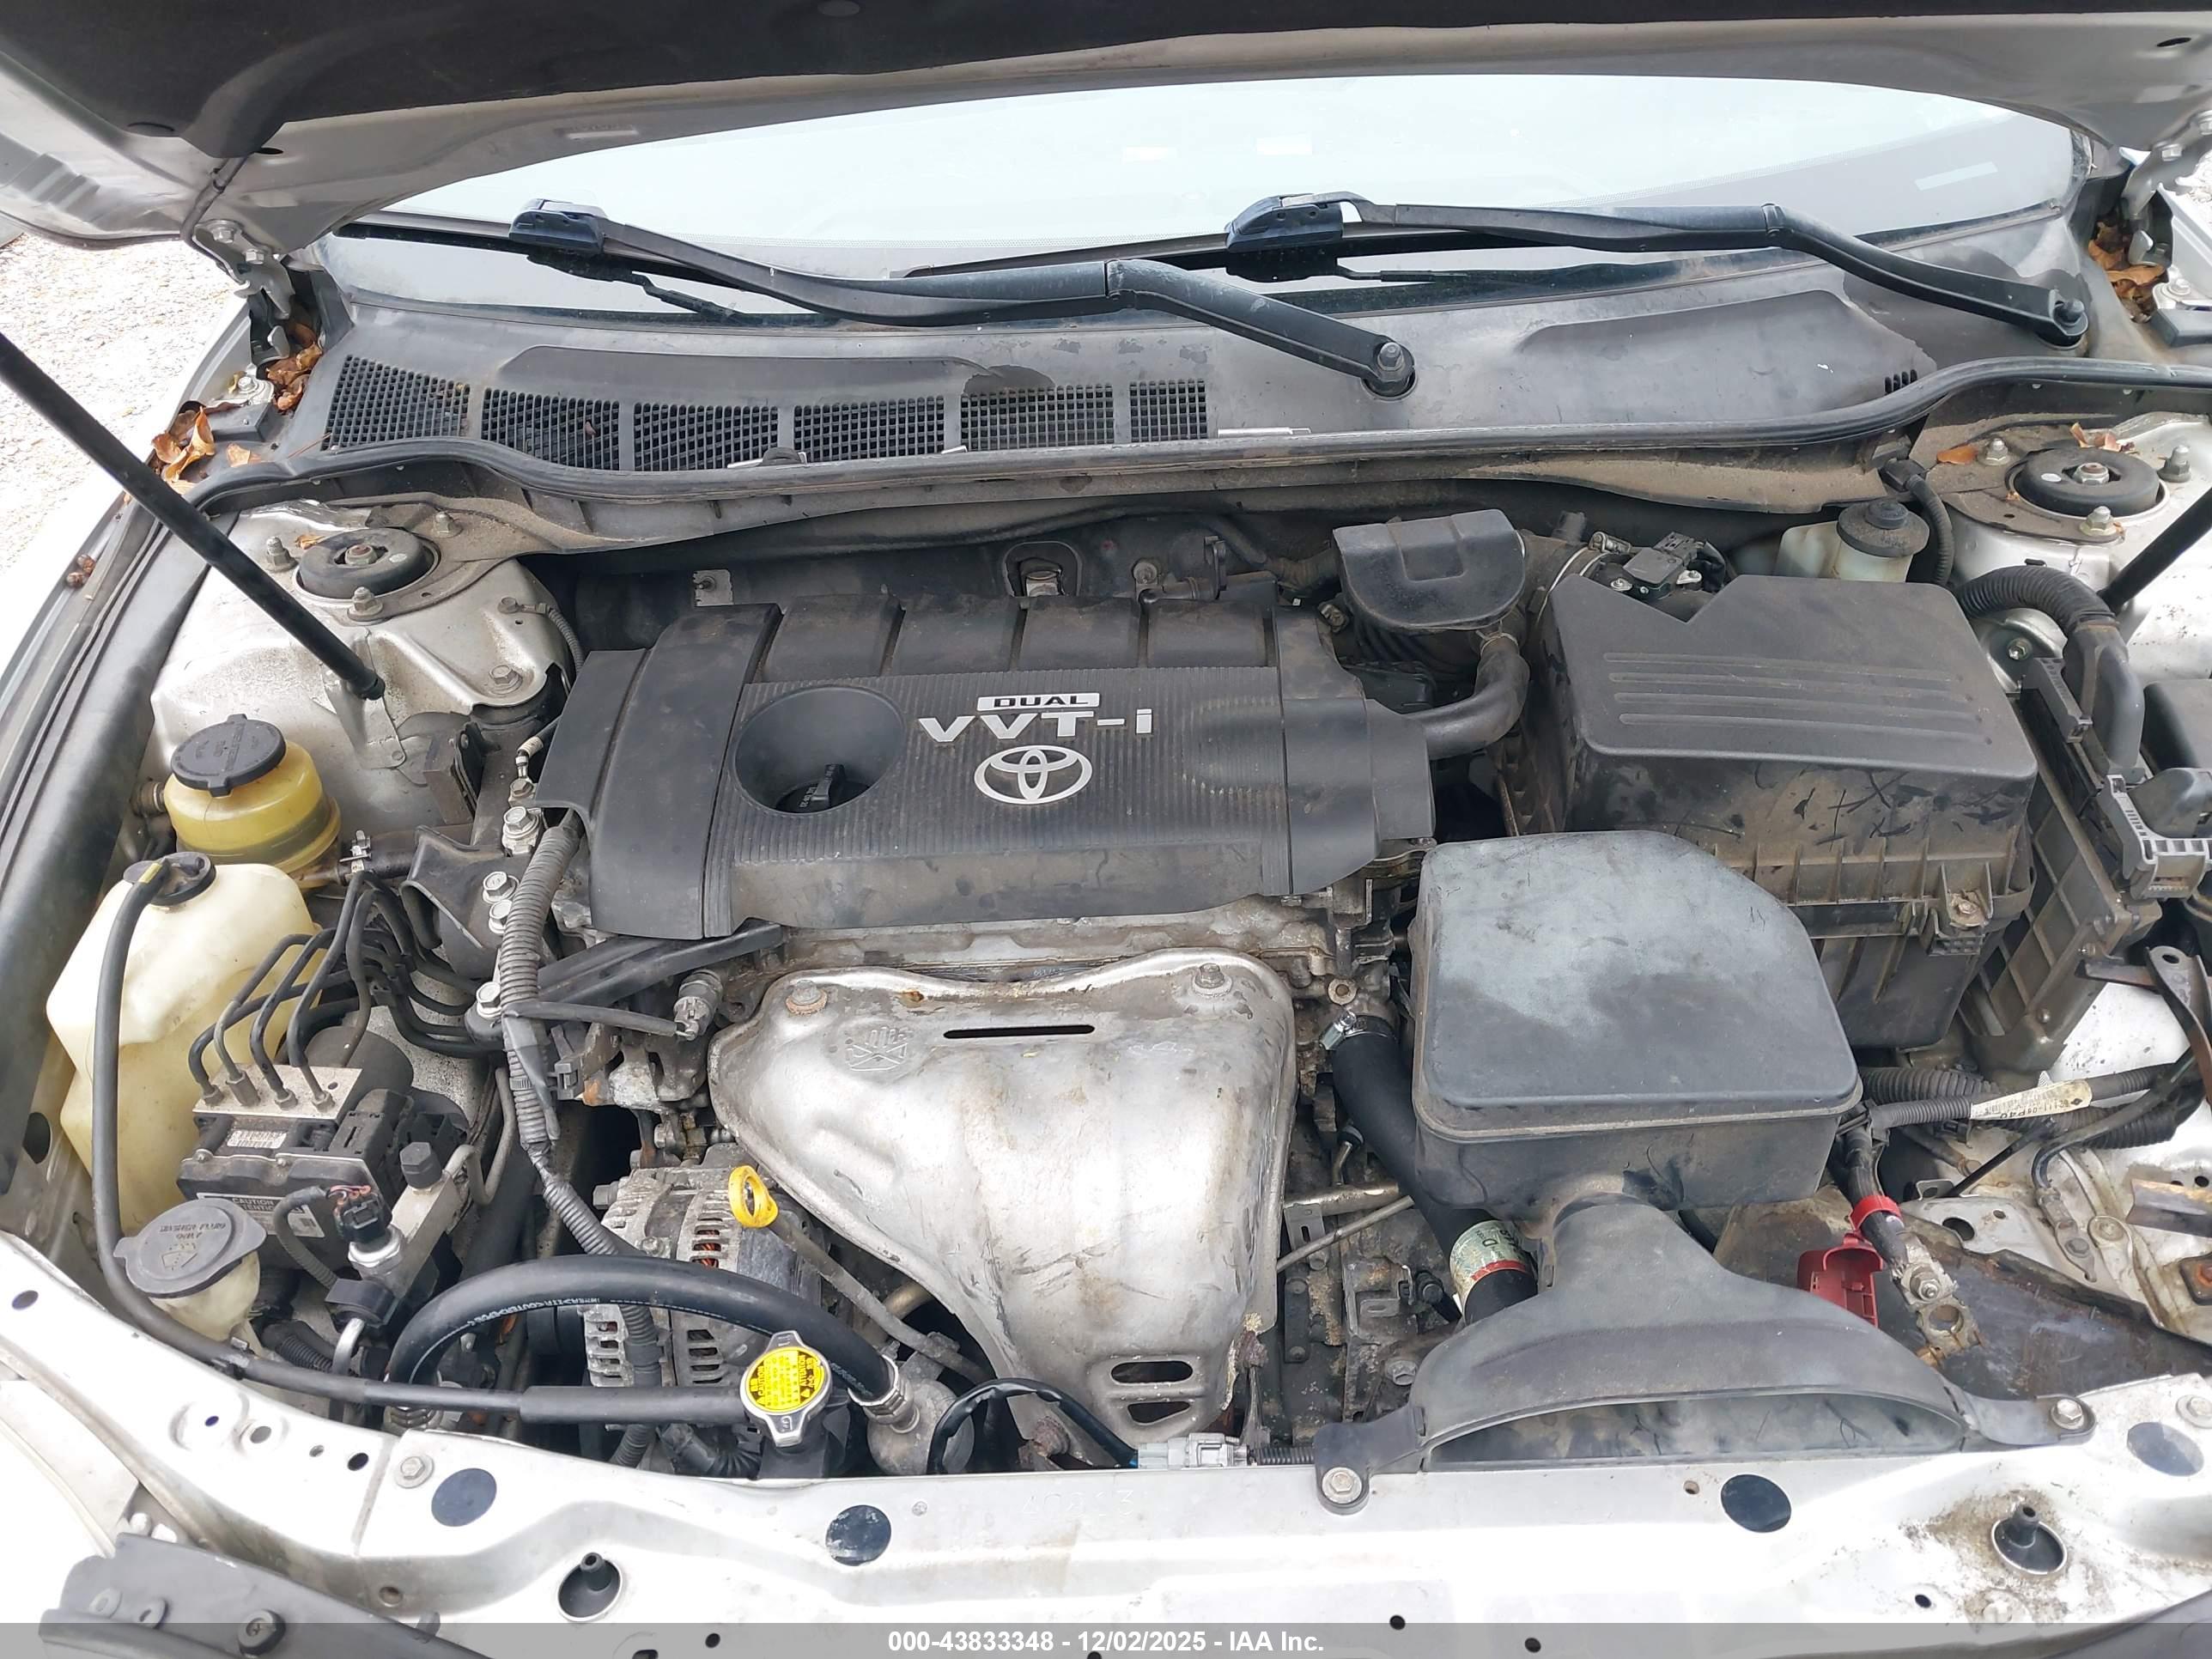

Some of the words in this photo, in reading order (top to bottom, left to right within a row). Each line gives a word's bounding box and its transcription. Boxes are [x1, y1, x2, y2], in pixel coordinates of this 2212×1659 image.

[994, 696, 1089, 708] DUAL
[918, 708, 1152, 743] VVT-i
[232, 1197, 274, 1206] CAUTION
